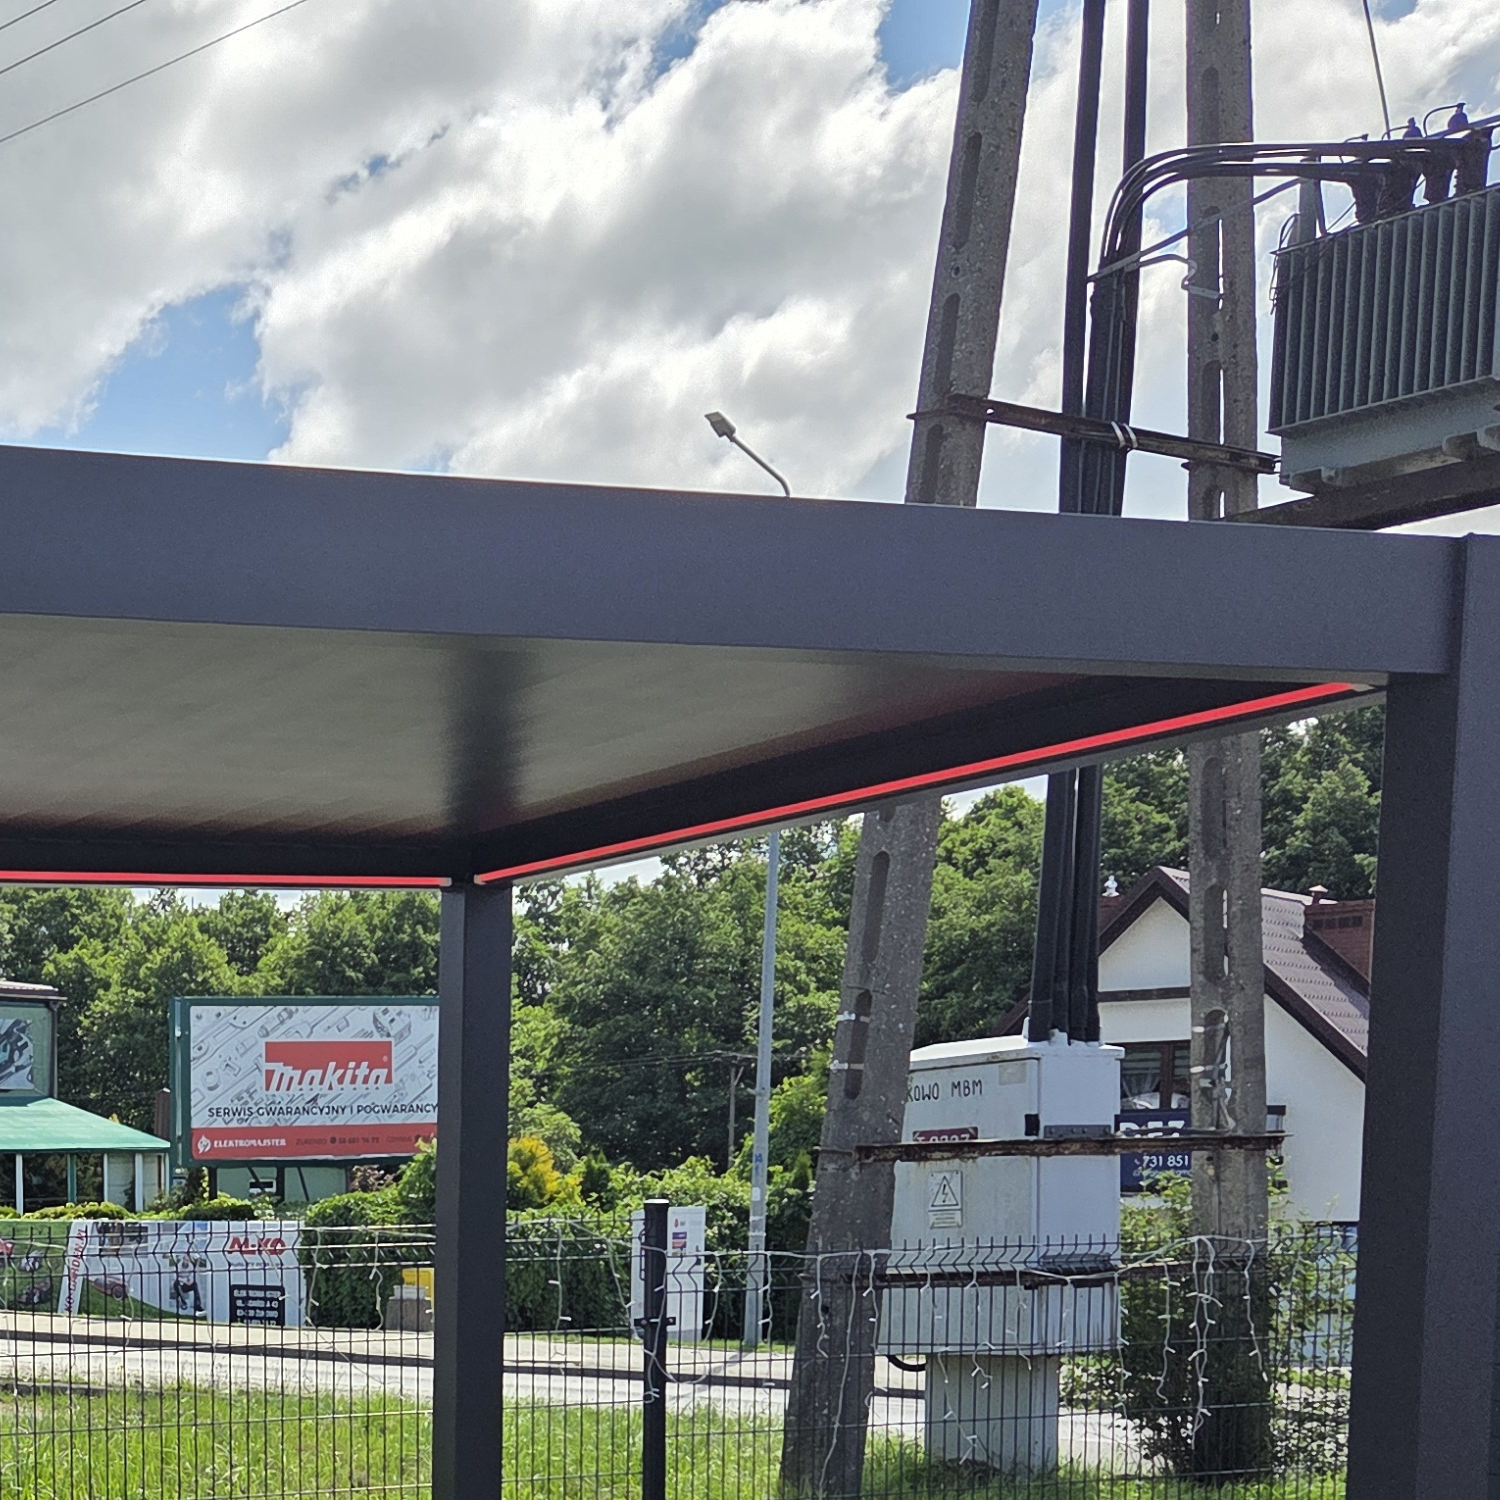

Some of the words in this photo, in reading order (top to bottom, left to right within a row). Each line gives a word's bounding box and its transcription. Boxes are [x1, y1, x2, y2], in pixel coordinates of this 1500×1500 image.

[951, 1079, 982, 1097] MBM
[207, 1106, 254, 1117] SERWIS
[257, 1105, 347, 1116] GWARANCYJNY
[1143, 1155, 1163, 1168] 731
[1167, 1155, 1188, 1167] 851
